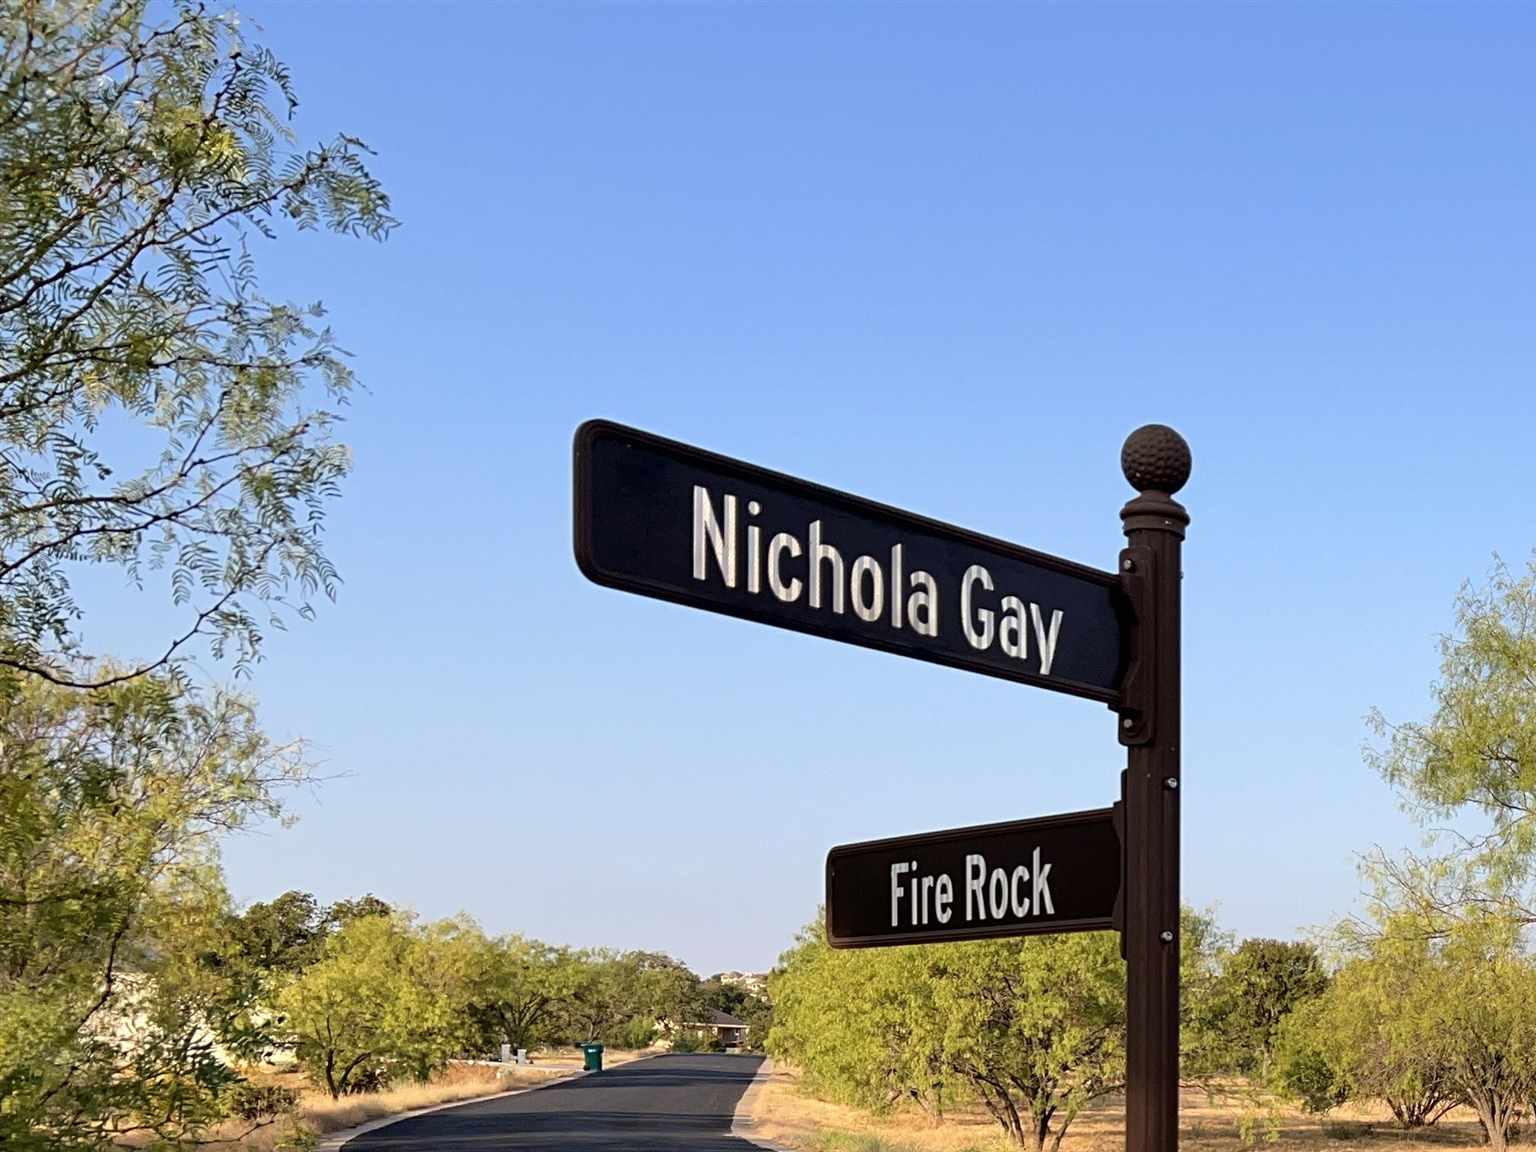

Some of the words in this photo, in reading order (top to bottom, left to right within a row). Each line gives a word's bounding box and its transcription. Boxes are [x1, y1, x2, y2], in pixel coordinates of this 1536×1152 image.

[692, 484, 938, 637] Nichola
[959, 564, 1064, 675] Gay
[890, 859, 953, 927] Fire
[964, 846, 1055, 921] Rock
